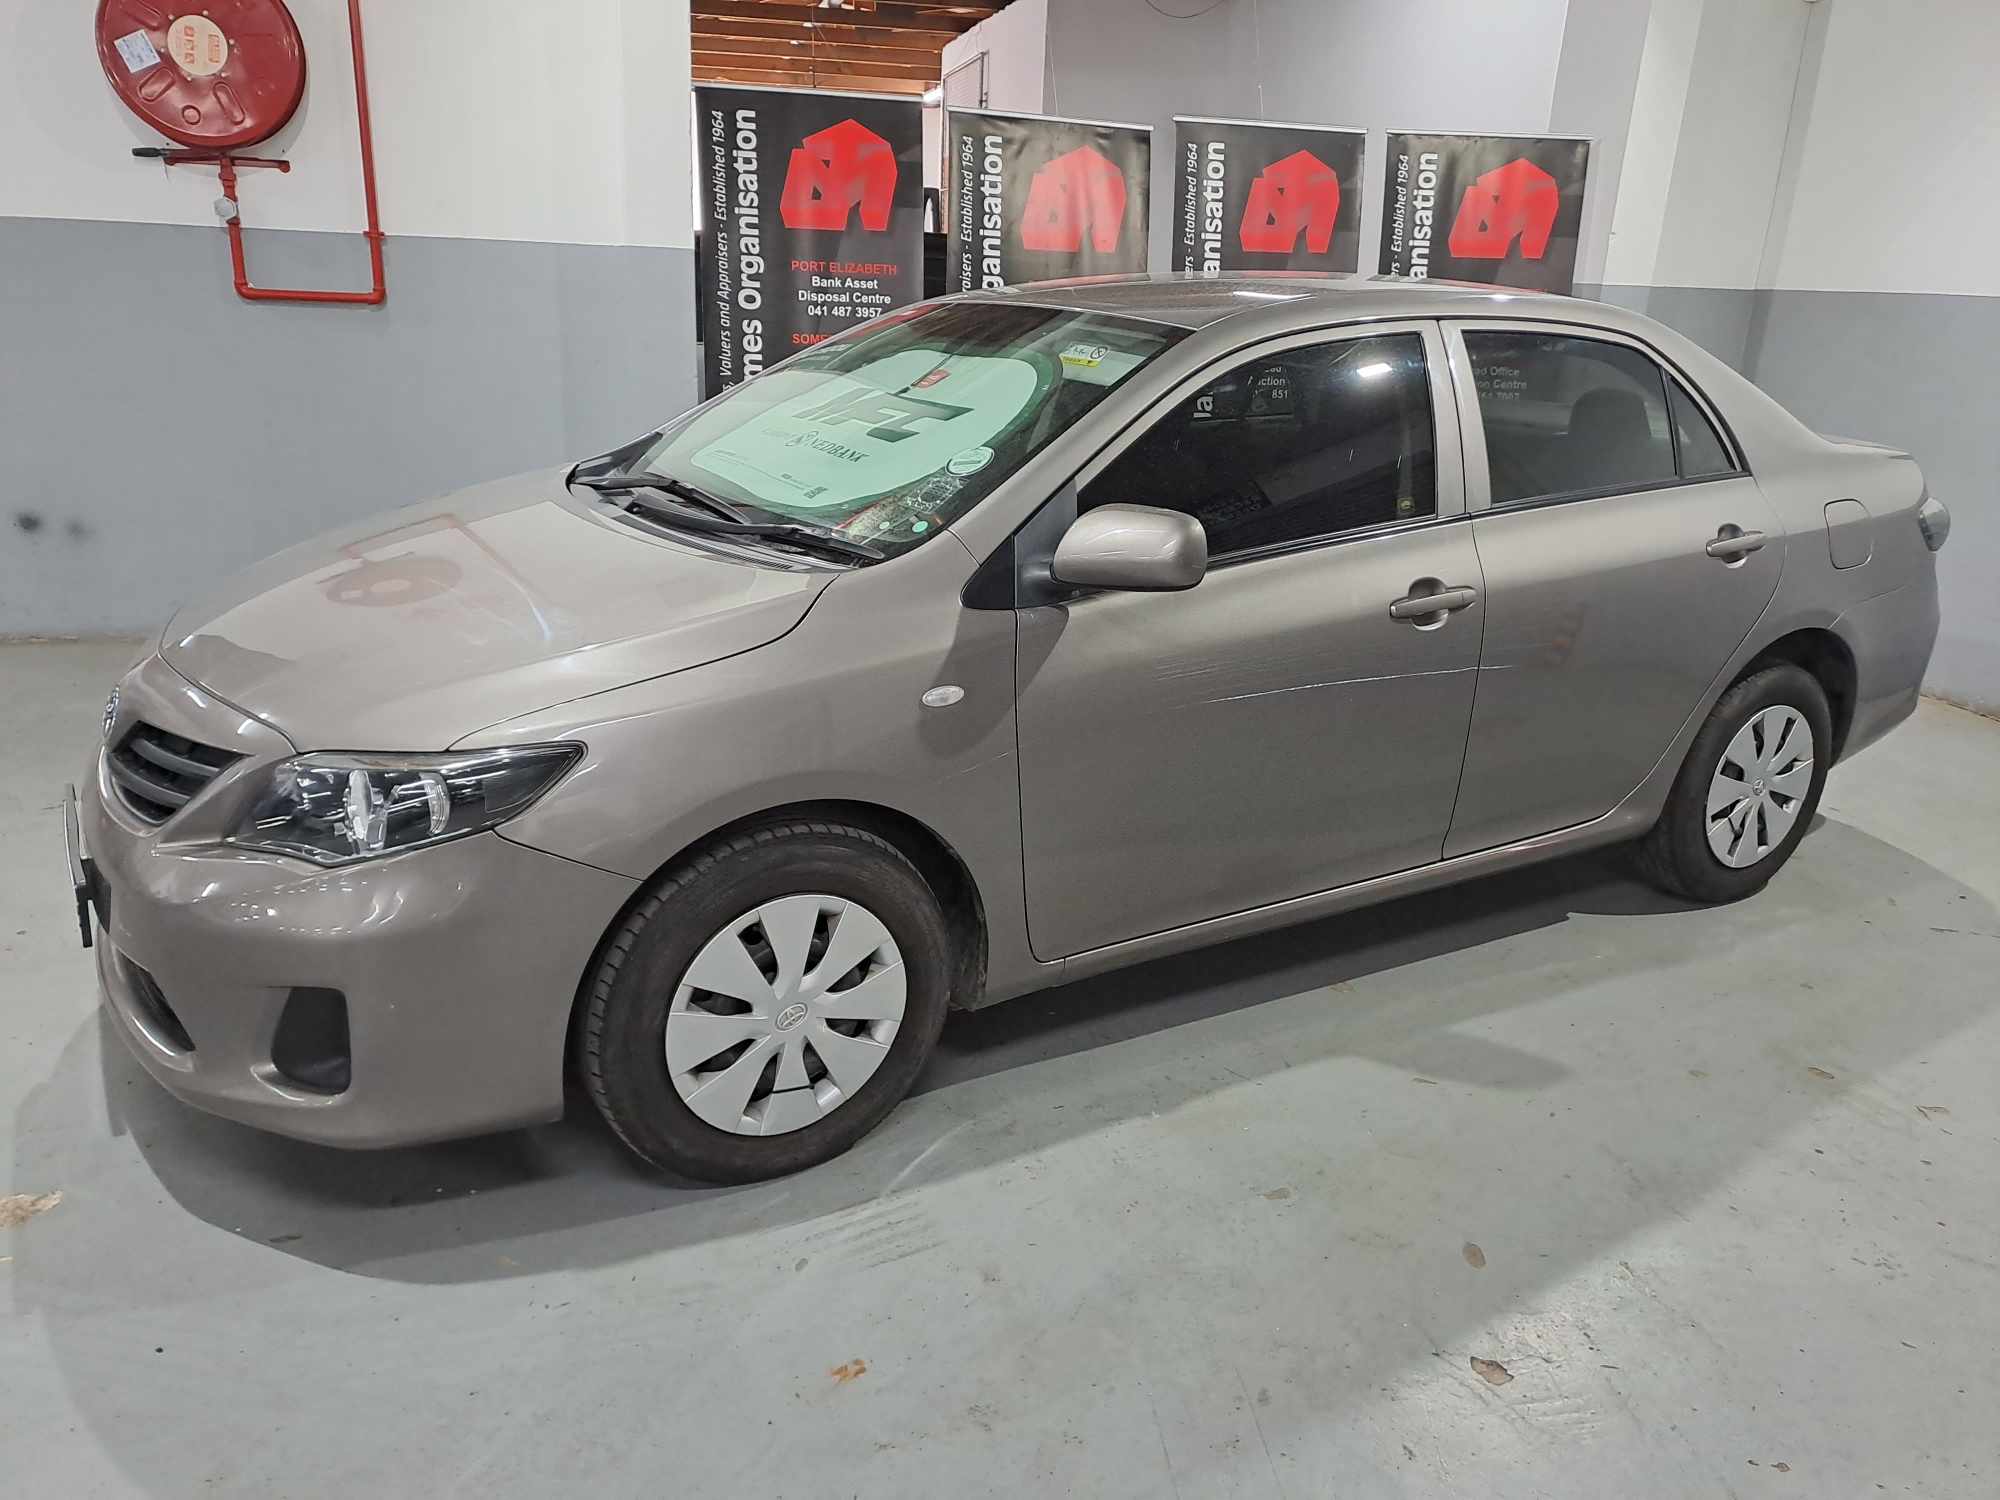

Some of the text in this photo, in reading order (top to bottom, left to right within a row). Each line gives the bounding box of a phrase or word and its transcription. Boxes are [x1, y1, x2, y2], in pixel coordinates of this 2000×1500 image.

[711, 110, 724, 143] 1964
[961, 136, 974, 168] 1964
[1187, 143, 1198, 174] 1964
[712, 145, 727, 222] Established
[1397, 154, 1409, 184] 1964
[733, 109, 764, 310] Organisation
[960, 169, 975, 242] Established
[1184, 175, 1197, 245] Established
[1391, 185, 1407, 252] Established
[714, 232, 733, 300] Appraisers
[791, 260, 897, 275] PORT ELIZABETH
[798, 290, 892, 305] Disposal Centre
[812, 276, 878, 289] Bank Asset
[716, 302, 730, 326] and
[807, 306, 882, 318] 041 487 3957
[719, 329, 732, 376] Valuers
[1271, 389, 1288, 399] 851
